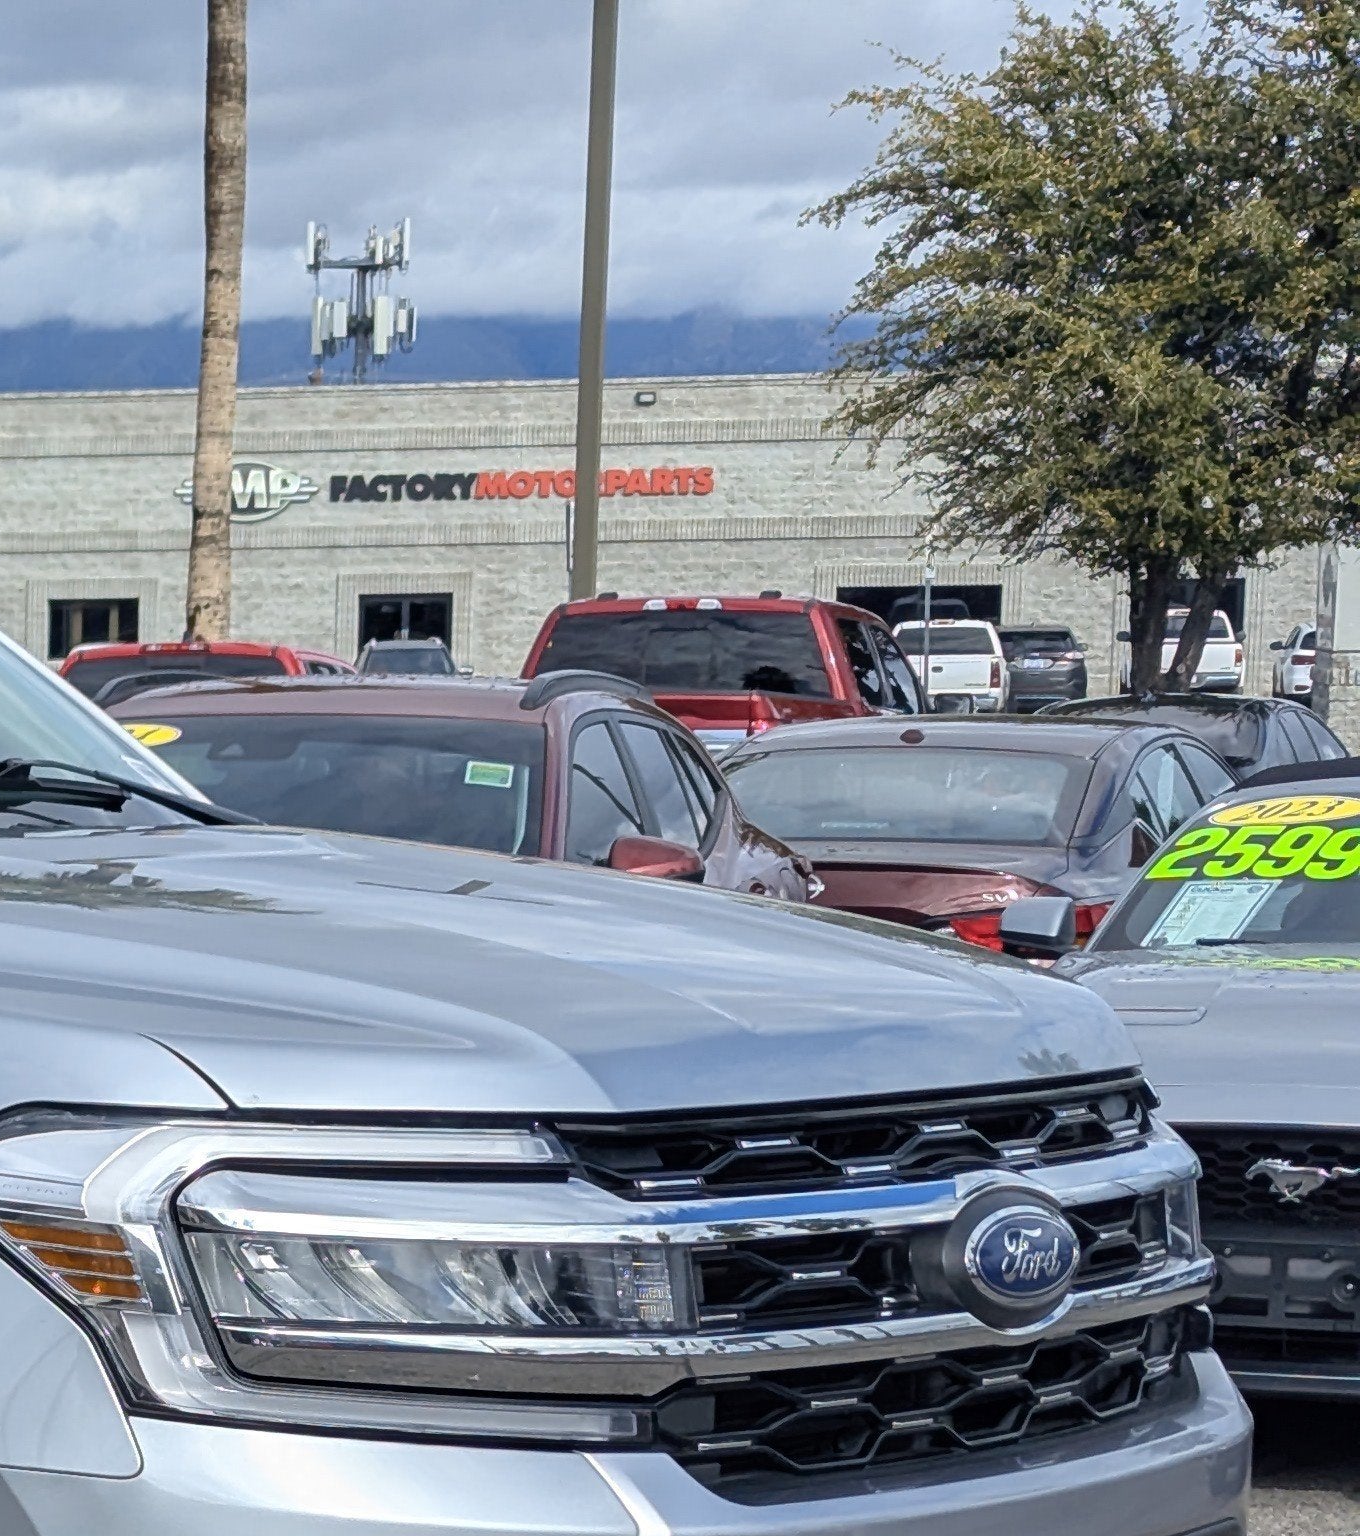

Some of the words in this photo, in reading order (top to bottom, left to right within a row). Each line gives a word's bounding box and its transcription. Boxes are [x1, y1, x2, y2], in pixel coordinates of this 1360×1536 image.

[231, 468, 301, 509] MP
[1231, 799, 1345, 821] 2023
[1001, 1227, 1061, 1284] Ford
